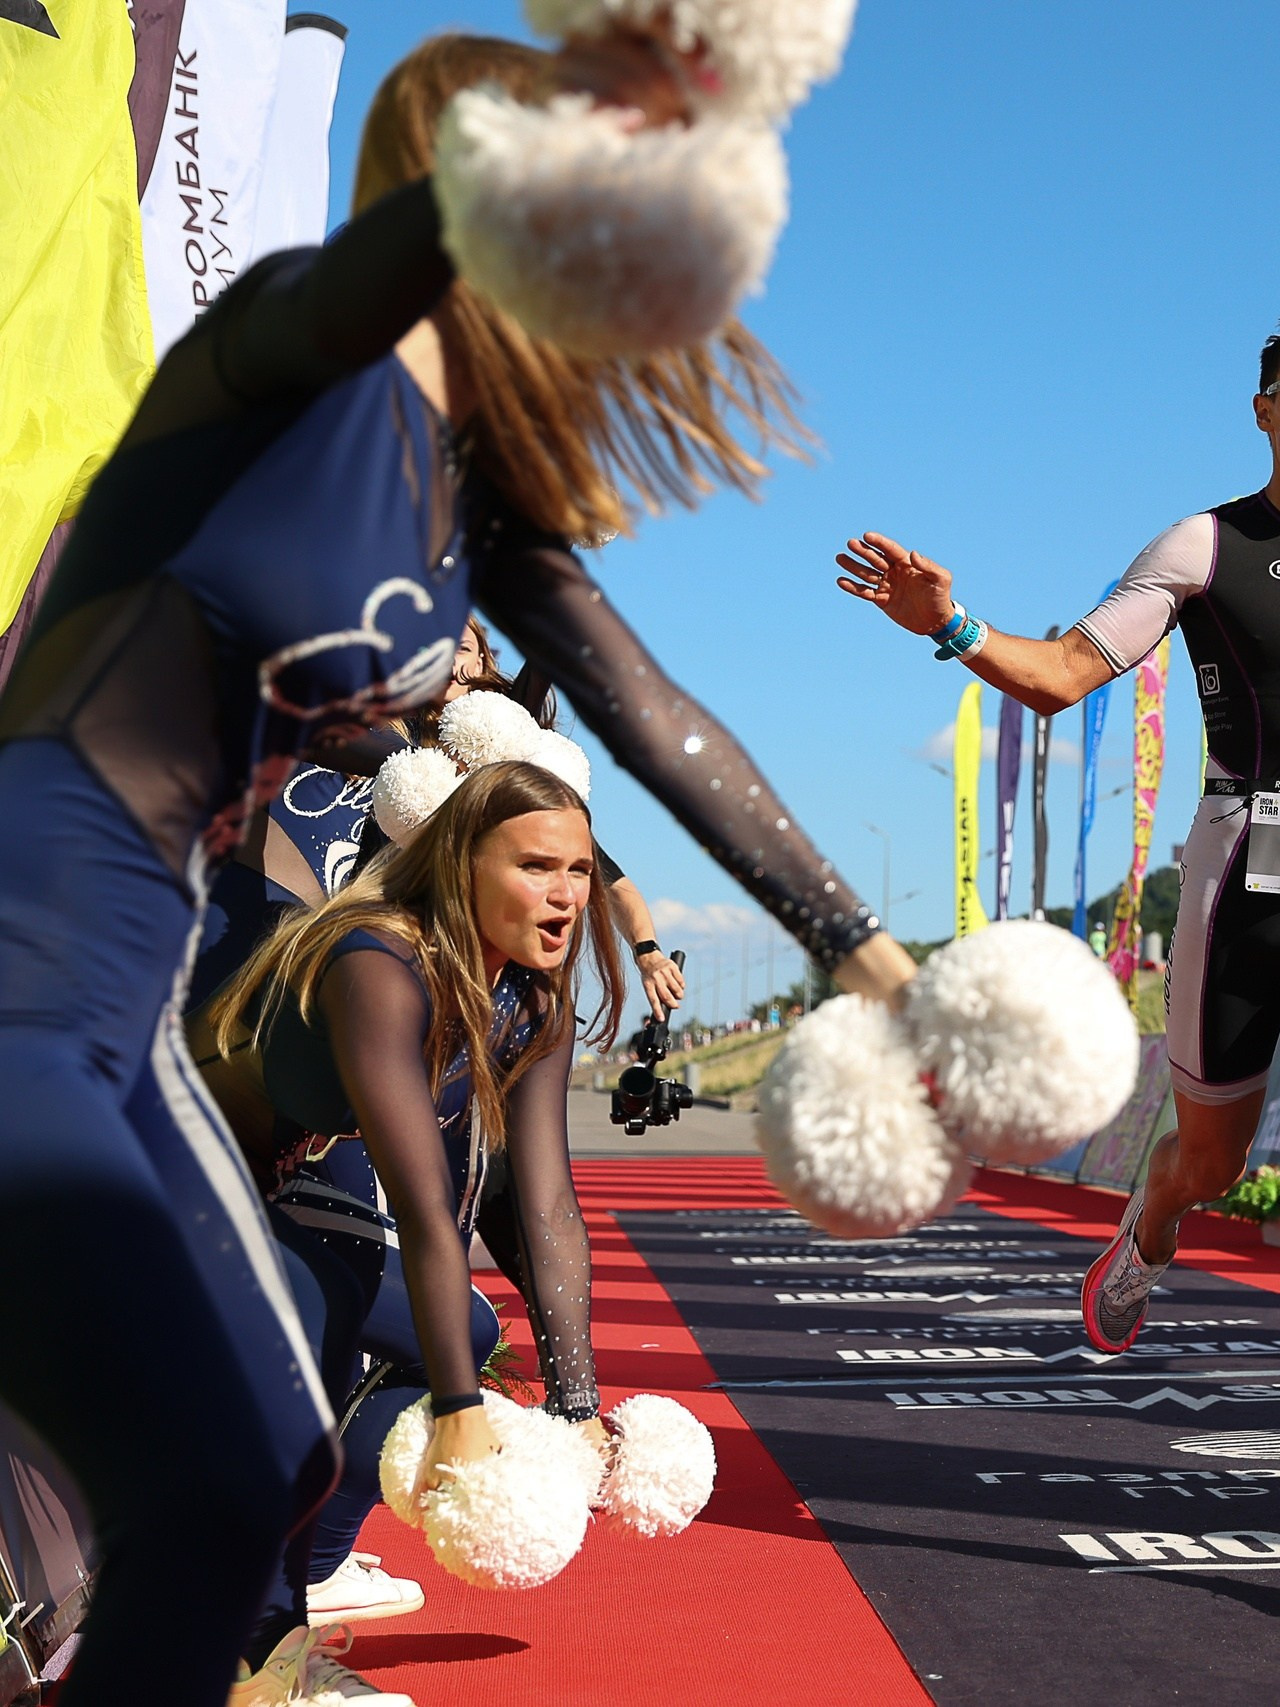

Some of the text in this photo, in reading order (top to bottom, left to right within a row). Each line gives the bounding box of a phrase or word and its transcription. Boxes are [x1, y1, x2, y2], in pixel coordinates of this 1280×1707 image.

[174, 48, 214, 326] РОМБАНК
[1260, 797, 1273, 807] IRON
[1259, 805, 1279, 816] STAR
[836, 1346, 1037, 1361] IRON
[884, 1389, 1120, 1405] IRON
